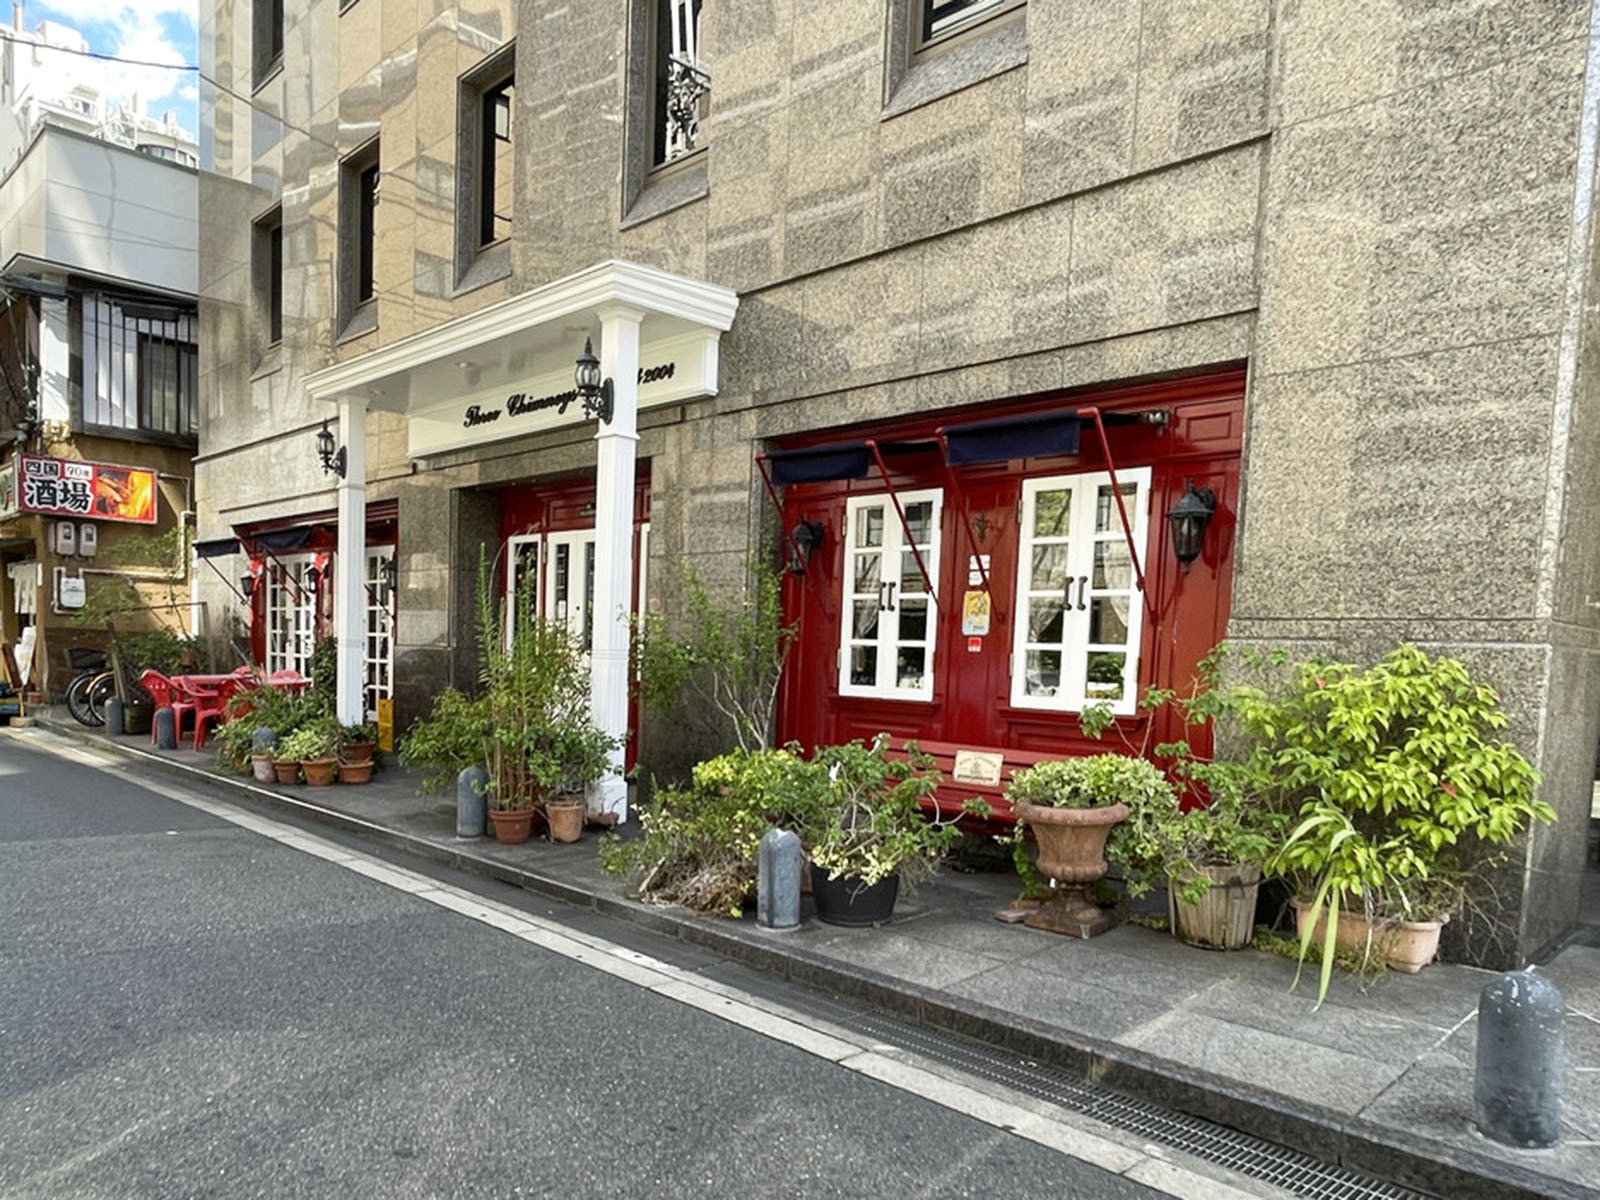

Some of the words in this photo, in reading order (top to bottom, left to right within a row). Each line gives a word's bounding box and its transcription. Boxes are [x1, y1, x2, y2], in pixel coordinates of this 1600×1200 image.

[463, 405, 501, 428] Three
[507, 388, 580, 415] Chimneys
[26, 461, 59, 476] 四国
[26, 477, 91, 511] 酒場
